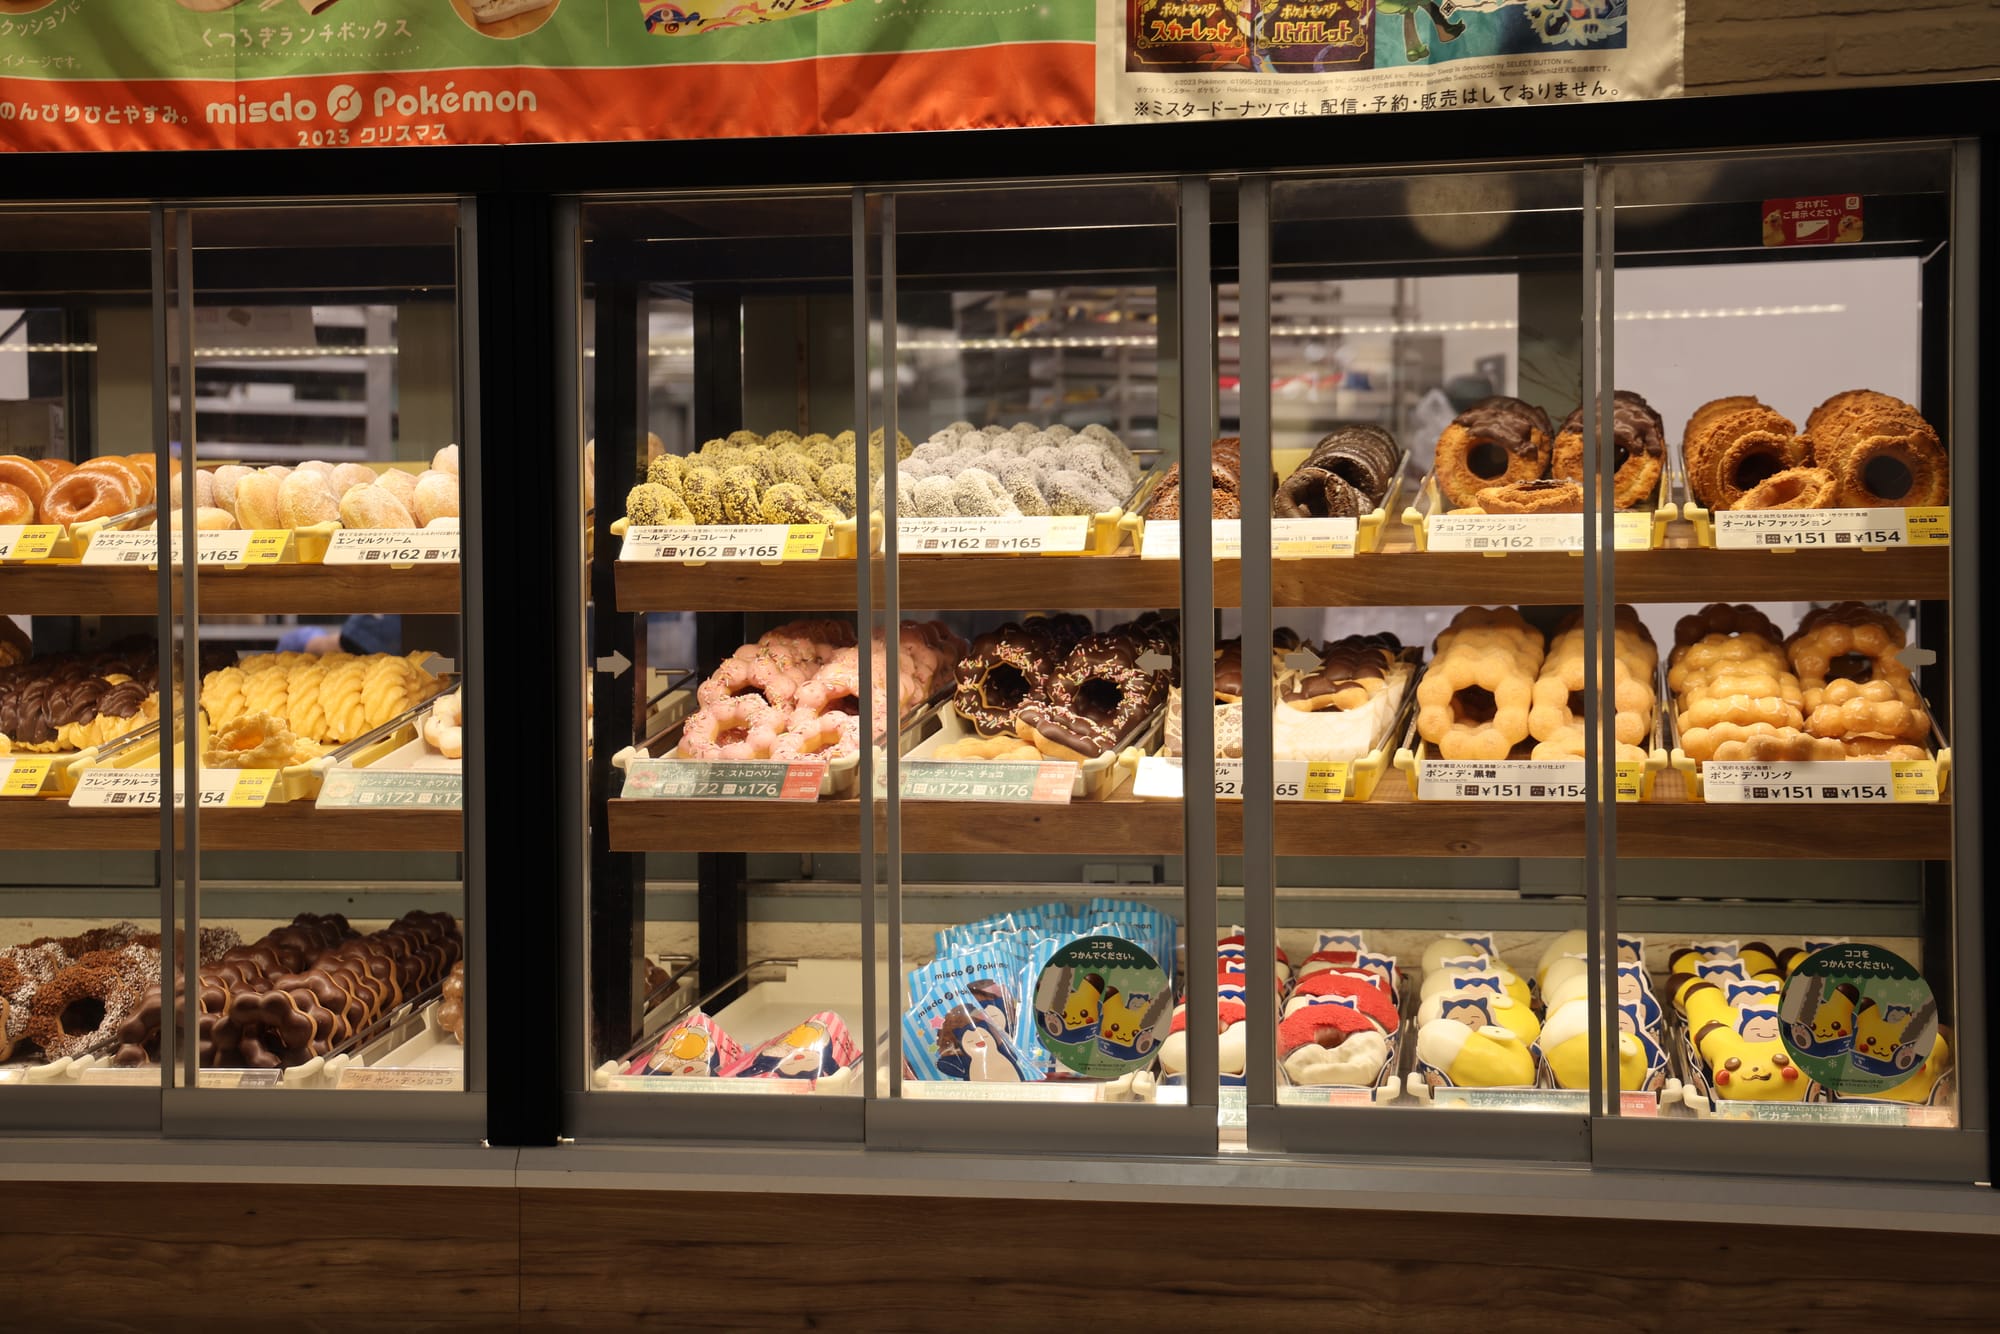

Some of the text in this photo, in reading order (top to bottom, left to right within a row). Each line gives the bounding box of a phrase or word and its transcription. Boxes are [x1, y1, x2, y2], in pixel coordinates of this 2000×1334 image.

[201, 19, 412, 48] くつろぎランチボックス
[1150, 19, 1233, 42] スカーレット
[1271, 20, 1353, 43] バイオレット
[205, 81, 537, 124] misdo Pokémon
[0, 102, 188, 124] のんびりひとやすみ。
[297, 123, 448, 147] 2023 クリスマス
[898, 525, 987, 533] コナツチョコレート
[1435, 523, 1527, 532] チョコファッション
[1722, 519, 1832, 528] オールドファッション
[336, 537, 411, 545] エンゼルクリーム
[631, 533, 737, 542] ゴールデンチョコレート
[941, 537, 1041, 549] ¥162 ¥165
[1491, 536, 1534, 548] ¥162
[1783, 532, 1826, 544] ¥151
[1854, 531, 1901, 543] ¥154
[199, 550, 239, 561] ¥165
[382, 549, 460, 560] ¥162 ¥1
[679, 546, 718, 557] ¥162
[739, 546, 778, 557] ¥165
[729, 769, 780, 778] ストロベリー
[909, 769, 1005, 778] ポン・デ・リース チョコ
[1425, 769, 1497, 779] ポン・デ・黒糖
[1710, 770, 1793, 780] ポン・デ・リング
[85, 778, 160, 786] フレンチクルーラ
[426, 778, 459, 787] ホワイト
[739, 783, 777, 795] ¥176
[930, 783, 1029, 797] ¥172 ¥176
[1482, 784, 1521, 797] ¥151
[1771, 786, 1813, 799] ¥151
[1841, 785, 1888, 799] ¥154
[376, 791, 462, 803] ¥172 ¥17
[1091, 941, 1113, 950] ココを
[1069, 951, 1135, 960] つかんでください。
[1844, 949, 1870, 959] ココを
[1820, 960, 1895, 971] つかんでください。
[934, 969, 963, 980] misdo
[918, 998, 944, 1018] misdo
